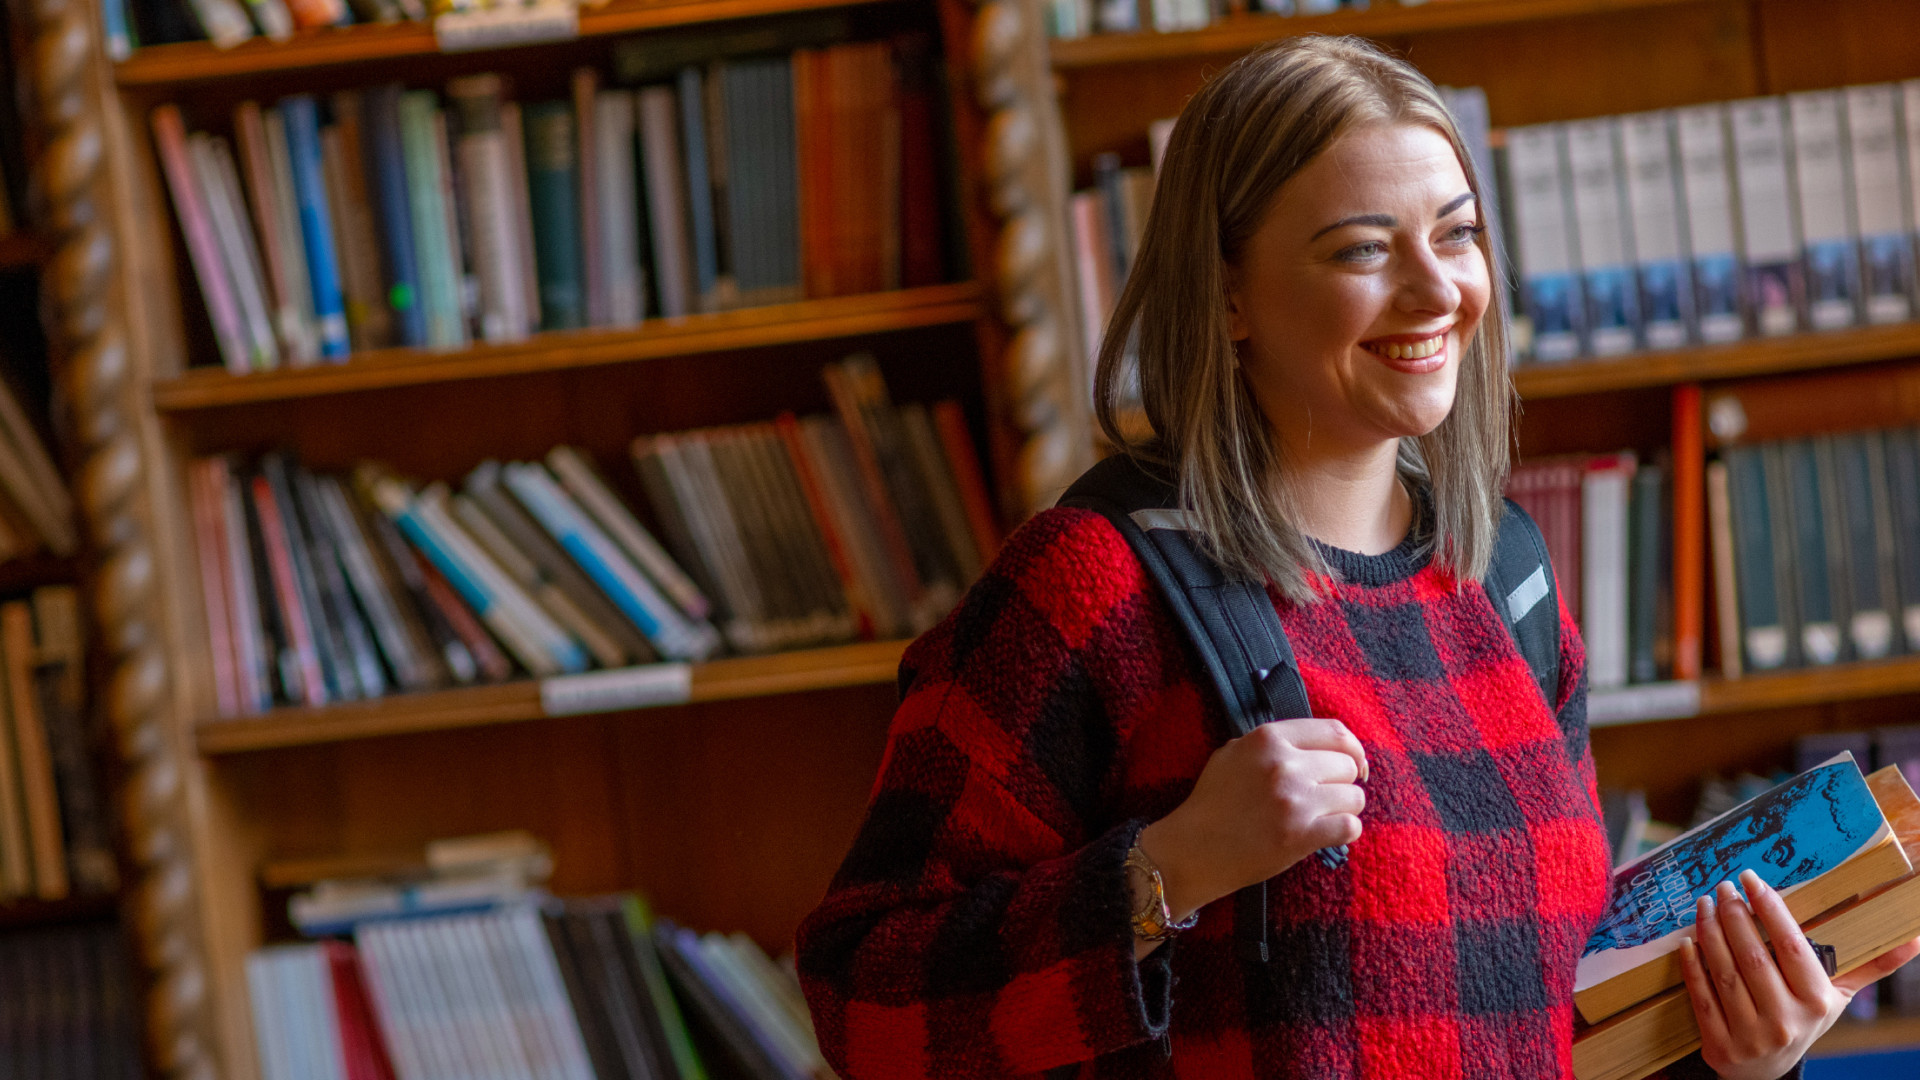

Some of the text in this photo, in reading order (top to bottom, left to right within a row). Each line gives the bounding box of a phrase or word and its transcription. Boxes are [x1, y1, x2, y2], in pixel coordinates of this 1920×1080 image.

[1630, 871, 1656, 889] OF
[1652, 849, 1698, 927] THE REPUBLIC
[1632, 885, 1669, 924] PLATO
